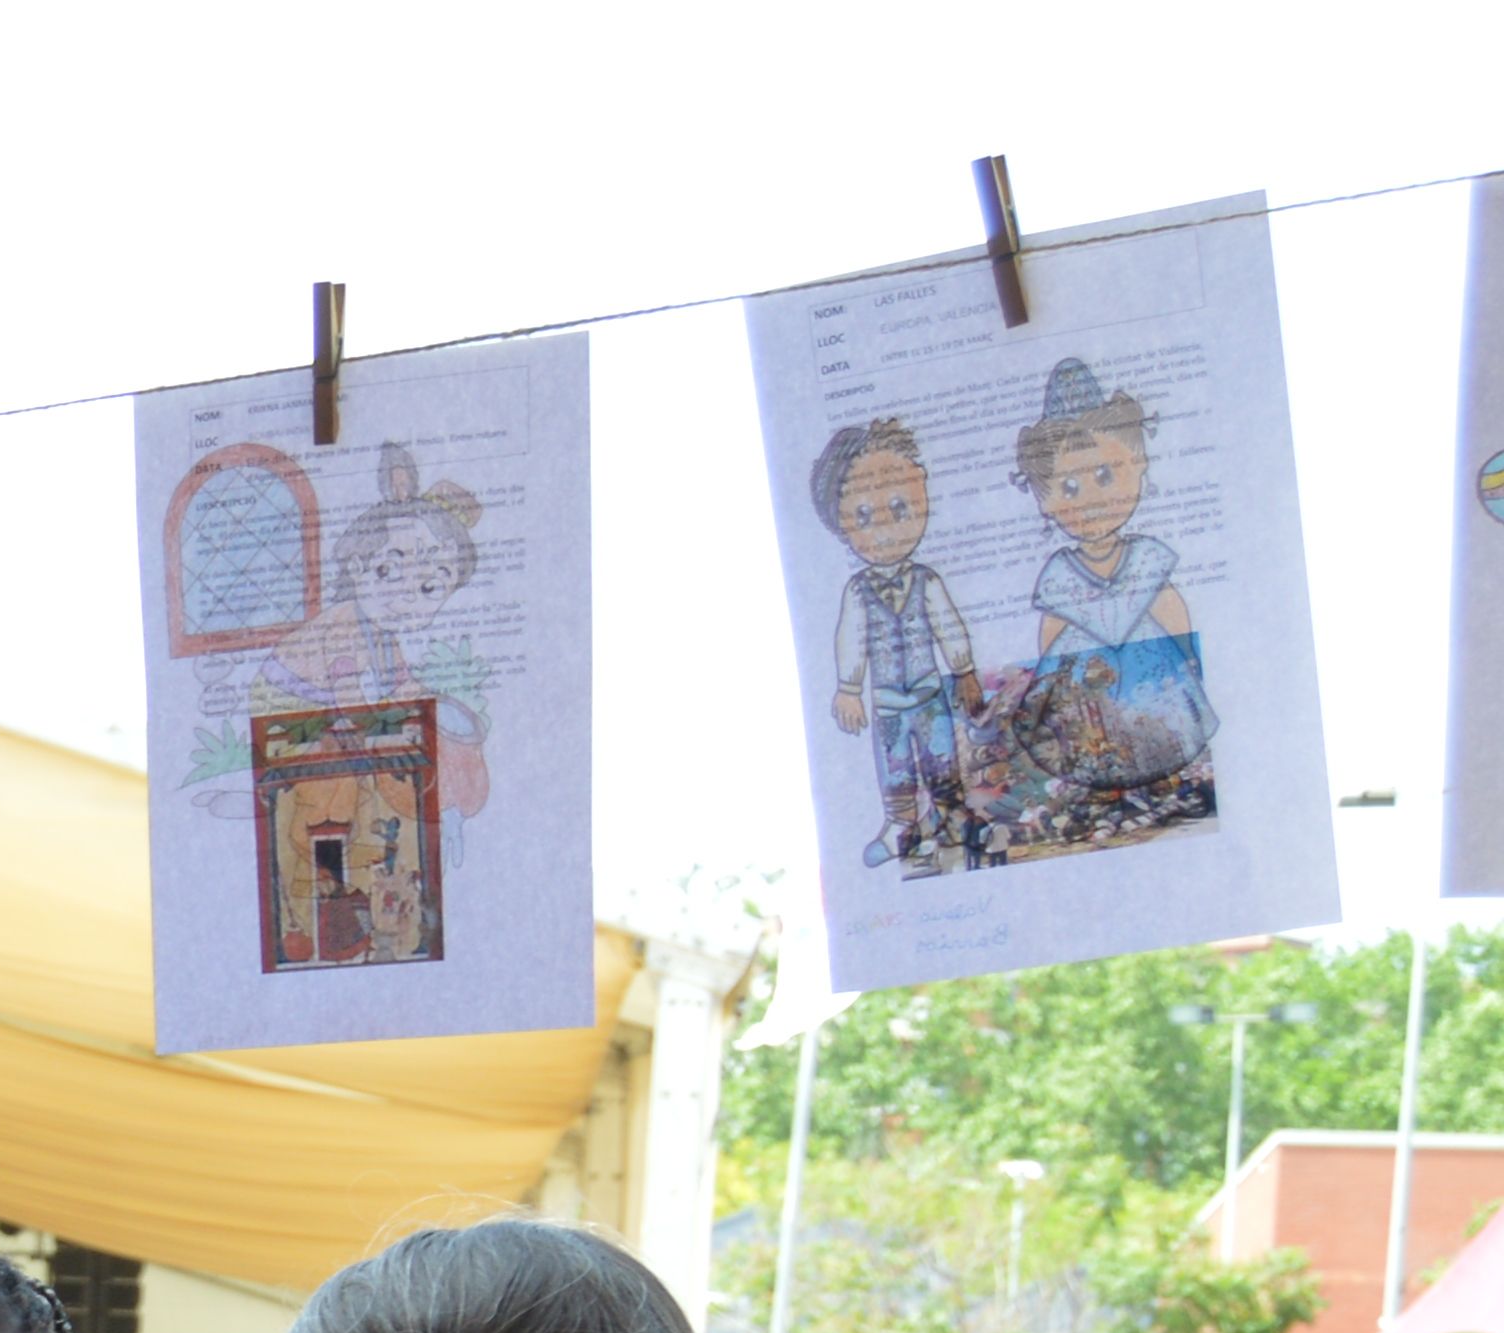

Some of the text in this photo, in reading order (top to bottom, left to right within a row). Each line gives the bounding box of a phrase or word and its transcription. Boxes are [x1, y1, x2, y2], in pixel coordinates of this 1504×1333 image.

[872, 293, 894, 308] LAS
[895, 284, 937, 302] FALLES
[816, 333, 846, 348] LLOC
[819, 360, 850, 375] DATA
[194, 463, 222, 474] DATA
